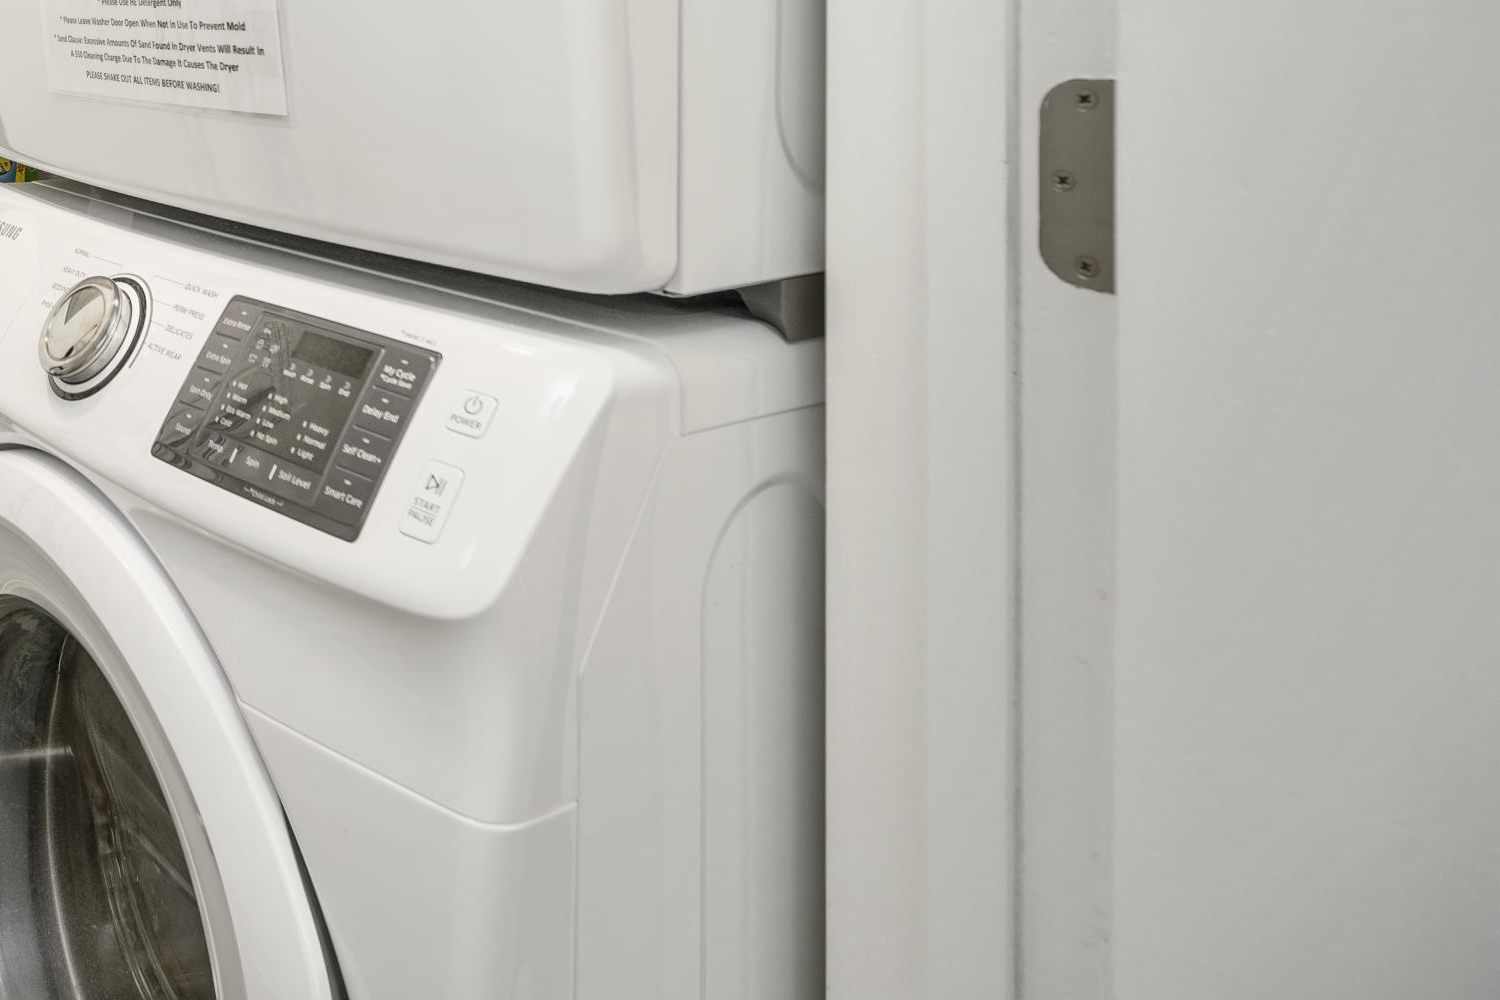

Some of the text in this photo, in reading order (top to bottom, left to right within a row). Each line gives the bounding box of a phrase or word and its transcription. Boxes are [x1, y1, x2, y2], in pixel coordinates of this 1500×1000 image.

[63, 16, 246, 32] Please Leave Washer Door Open When Not In Use To Prevent Mold
[83, 36, 106, 46] Excessive
[106, 38, 130, 48] Amounts
[130, 39, 138, 48] Of
[138, 39, 152, 49] Sand
[152, 40, 171, 51] Found
[171, 42, 178, 51] In
[178, 42, 196, 53] Dryer
[196, 43, 217, 53] Vents
[217, 44, 231, 54] Will
[232, 45, 255, 55] Result
[256, 46, 265, 56] In
[83, 51, 104, 63] Cleaning
[103, 53, 122, 64] Charge
[121, 54, 133, 64] Due
[132, 55, 141, 64] To
[141, 55, 153, 65] The
[152, 57, 177, 69] Damage
[183, 59, 206, 70] Causes
[205, 61, 219, 71] The
[219, 61, 240, 73] Dryer
[86, 70, 221, 93] PLEASE SHAKE OUT ALL ITEMS BEFORE WASHING!
[383, 364, 416, 383] My Cycle
[362, 404, 400, 423] Delay End
[451, 413, 483, 429] POWER
[341, 443, 358, 457] Self
[278, 469, 312, 490] Soil Level
[323, 485, 364, 509] Smart Care
[413, 496, 441, 511] START
